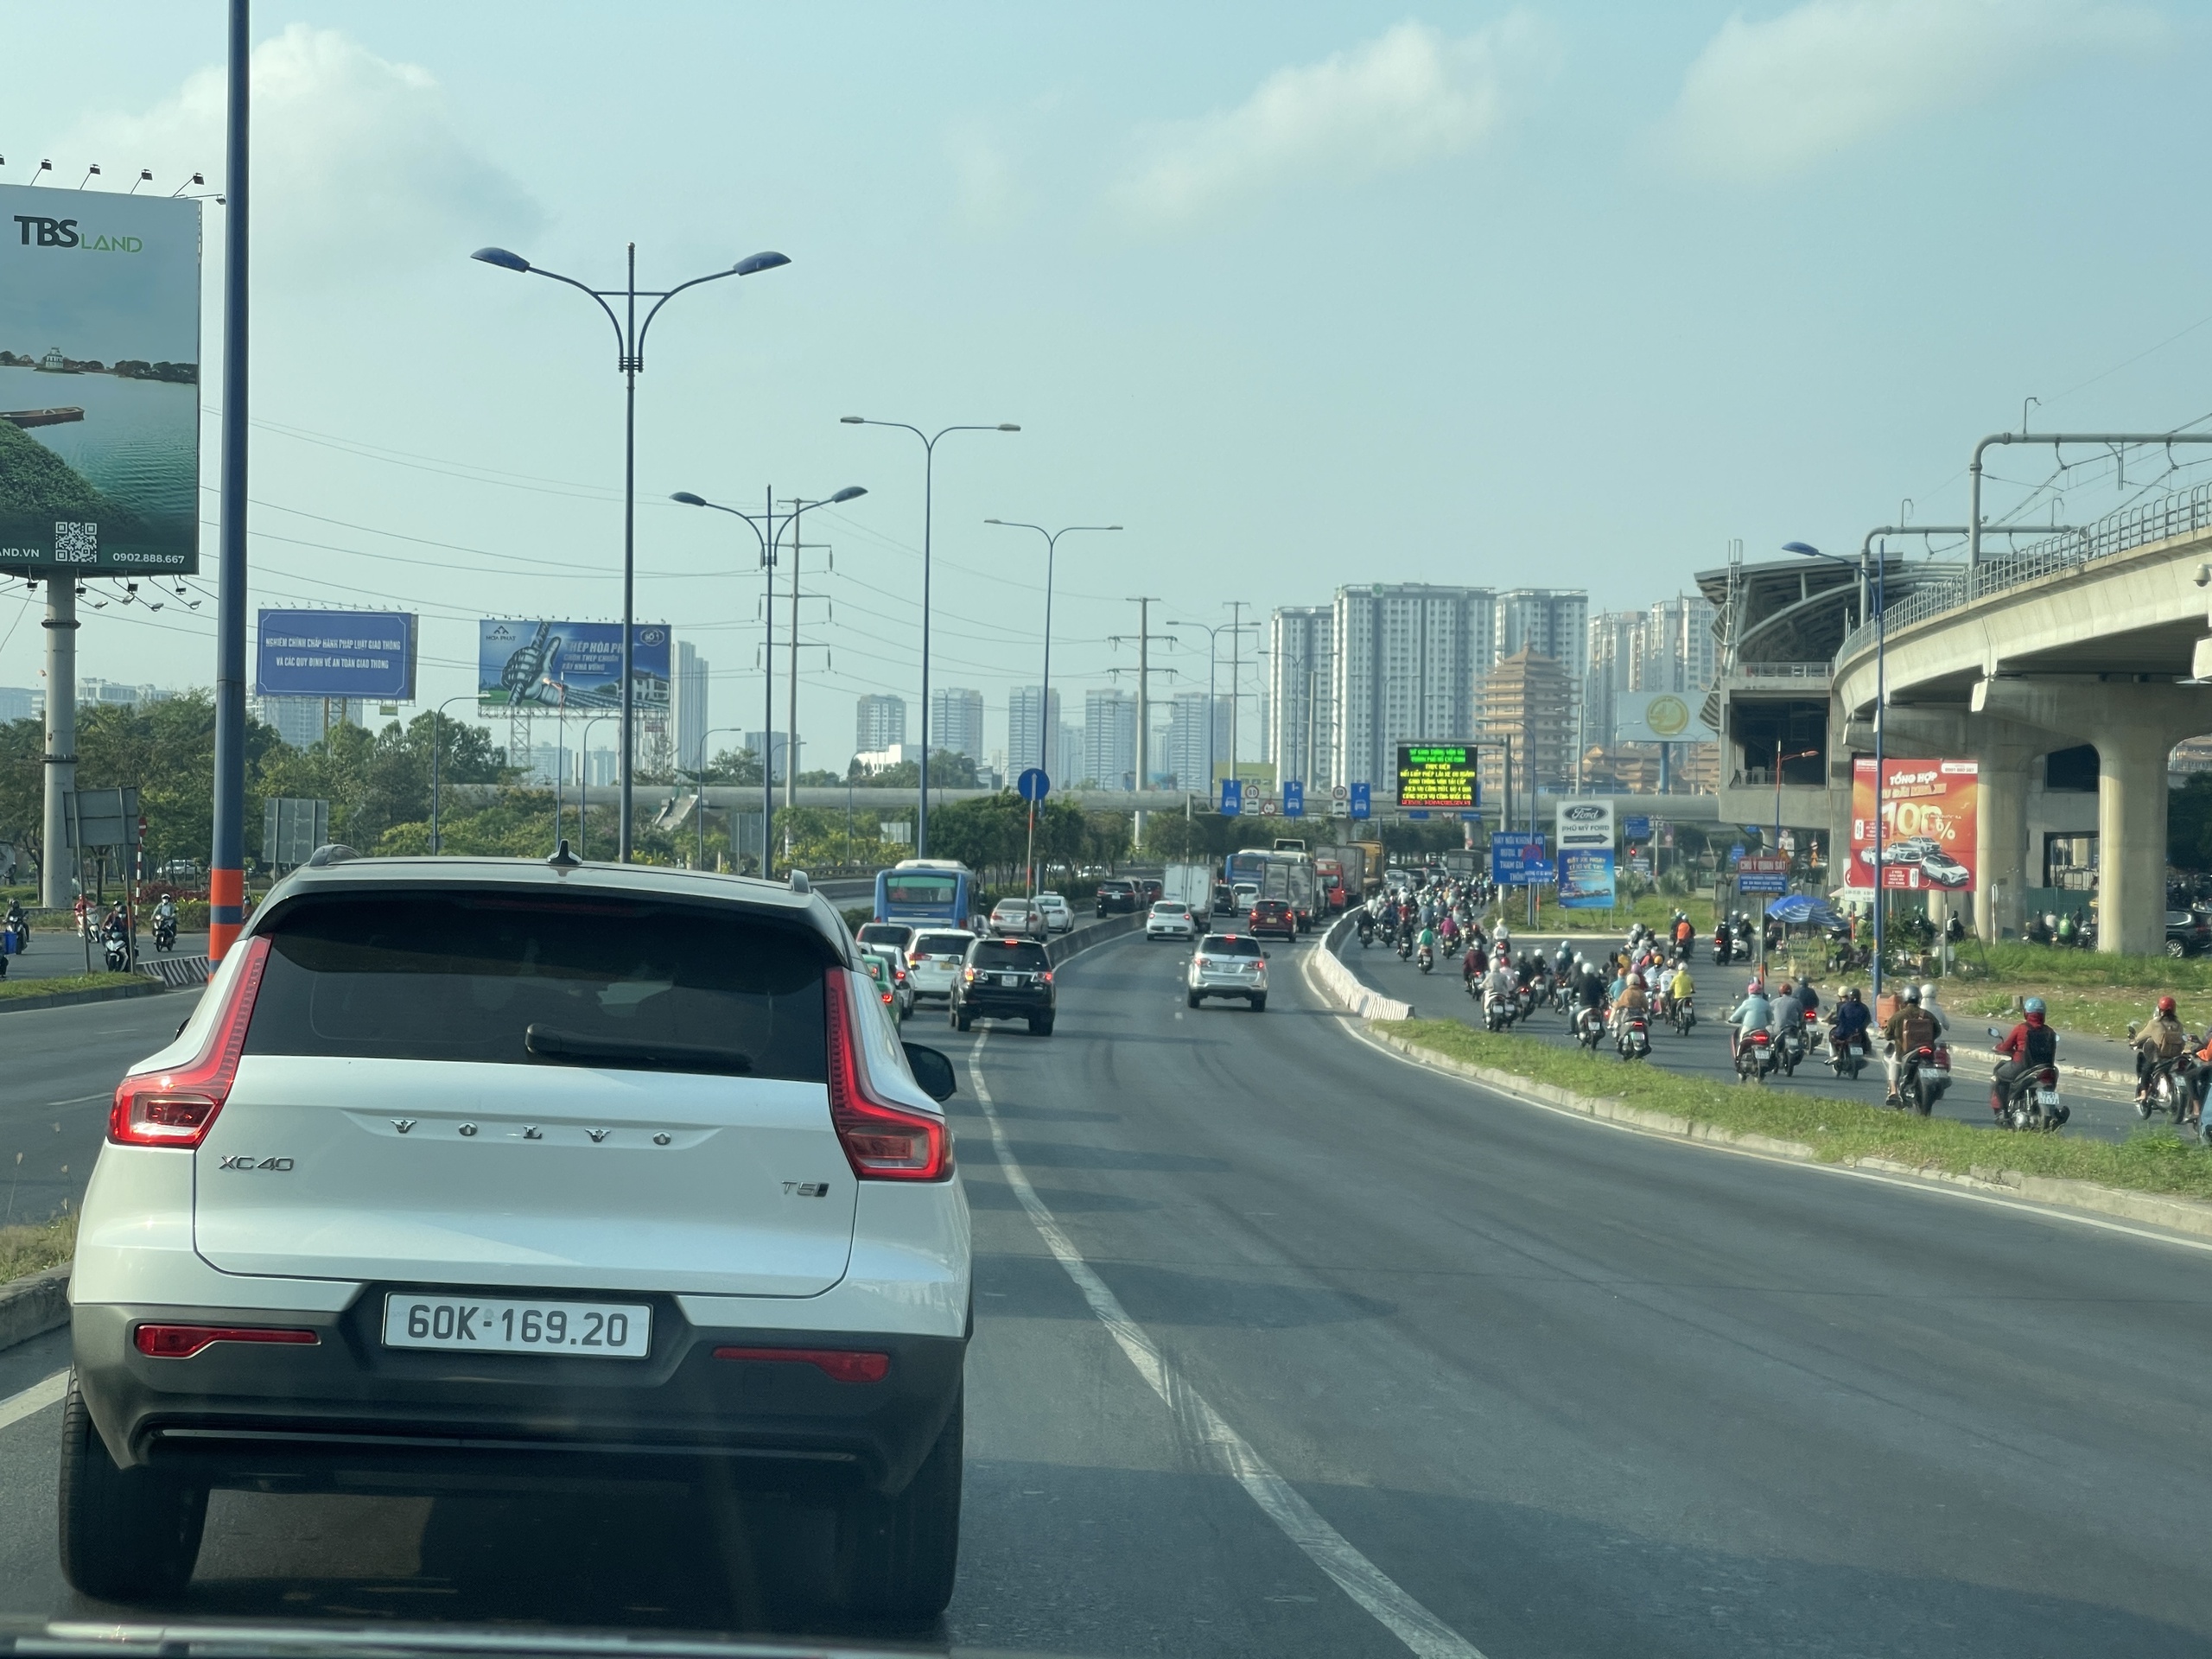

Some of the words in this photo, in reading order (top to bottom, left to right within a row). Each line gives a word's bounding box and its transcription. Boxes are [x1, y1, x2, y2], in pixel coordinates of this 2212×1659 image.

[14, 215, 79, 248] TBS
[81, 233, 143, 252] LAND
[112, 552, 185, 564] 0902.888.667
[368, 639, 381, 650] GIAO
[296, 657, 308, 667] QUY
[332, 658, 340, 667] AN
[356, 658, 370, 669] GIAO
[1890, 772, 1916, 785] TỔNG
[1916, 771, 1938, 785] HỢP
[1572, 807, 1599, 819] Ford
[391, 1119, 671, 1146] VOLVO
[219, 1155, 294, 1171] XC40
[408, 1305, 628, 1346] 60K-169.20
